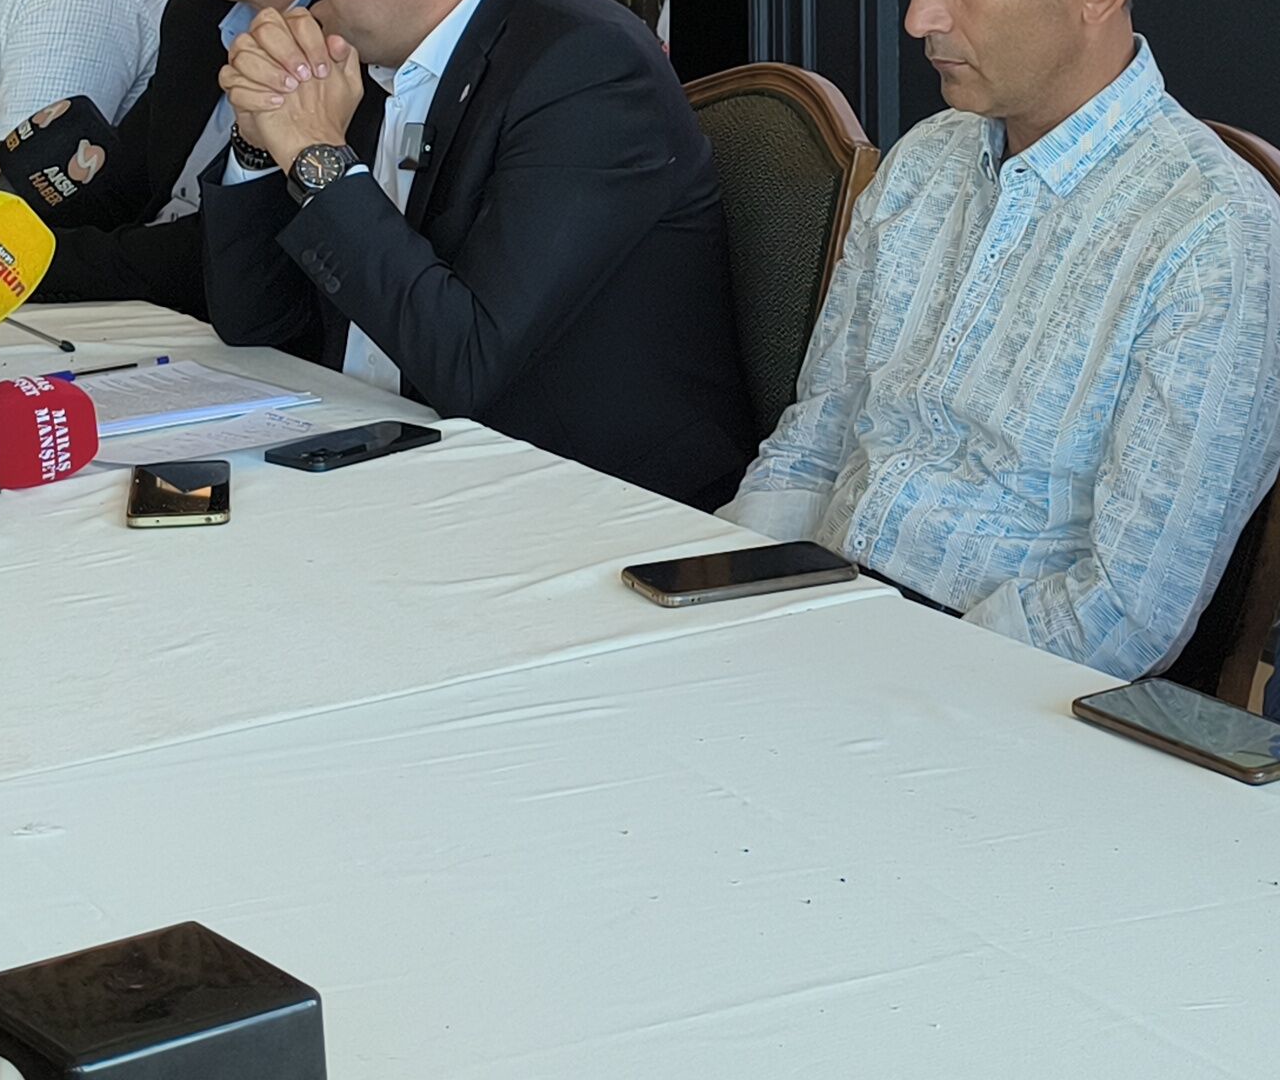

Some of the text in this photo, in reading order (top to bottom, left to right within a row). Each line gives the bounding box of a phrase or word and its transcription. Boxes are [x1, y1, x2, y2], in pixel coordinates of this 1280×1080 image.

[28, 171, 64, 207] HABER
[43, 166, 79, 197] AKSU
[34, 407, 56, 480] MANŞET
